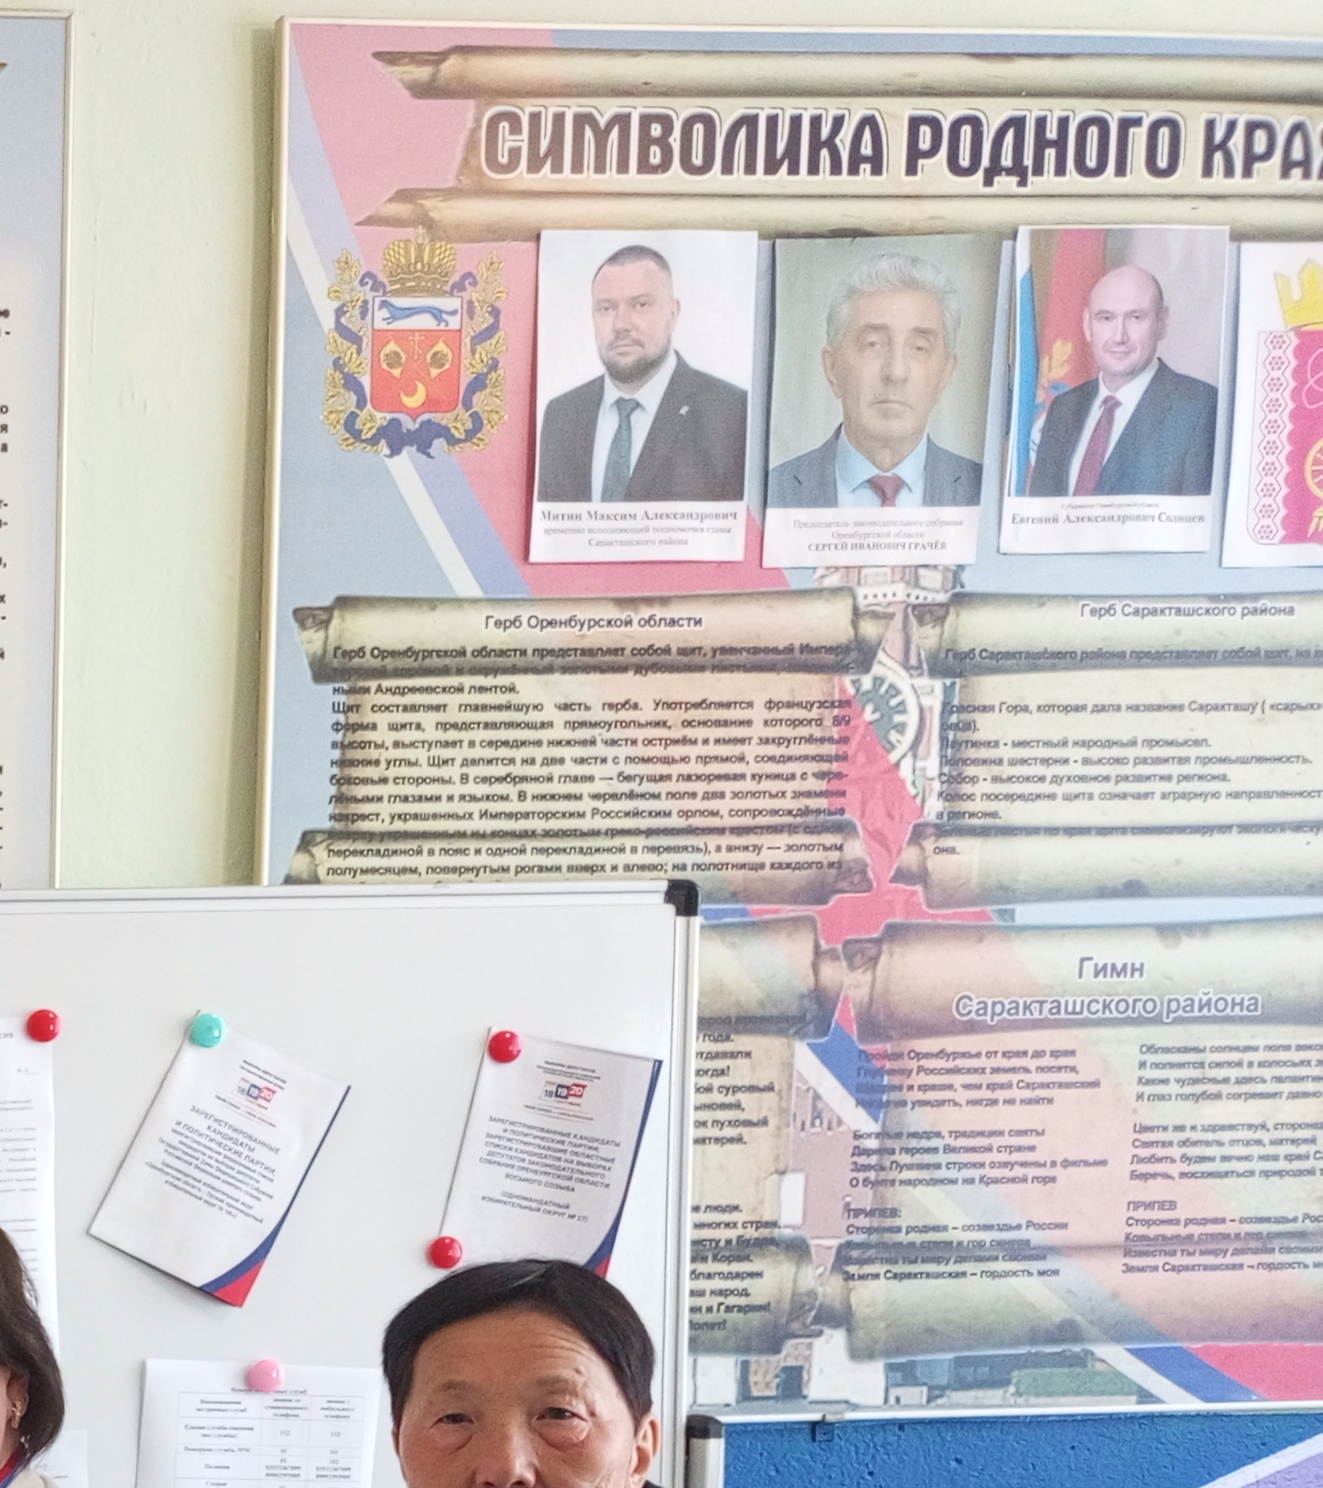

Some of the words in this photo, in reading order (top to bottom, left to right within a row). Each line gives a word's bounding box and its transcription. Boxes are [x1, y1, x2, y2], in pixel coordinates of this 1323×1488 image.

[485, 106, 889, 177] СИМВОЛИКА
[905, 114, 1182, 188] РОДНОГО
[1201, 118, 1323, 180] КРА
[541, 510, 583, 522] Митин
[586, 510, 637, 522] Максим
[641, 510, 738, 524] Александрович
[1011, 513, 1059, 525] Евгений
[1062, 513, 1156, 525] Александрович
[1157, 511, 1205, 523] Солнцев
[485, 614, 523, 633] Герб
[637, 613, 703, 628] области
[1080, 603, 1117, 621] Герб
[1121, 603, 1237, 620] Саракташского
[1240, 603, 1295, 620] района
[1078, 956, 1145, 980] Гимн
[953, 994, 1158, 1021] Саракташского
[1164, 991, 1262, 1022] района
[181, 1123, 244, 1159] ПОЛИТИЧЕСКИЕ
[189, 1104, 281, 1155] ЗАРЕГИСТРИРОВАННЫЕ
[206, 1124, 256, 1153] КАНДИДАТЫ
